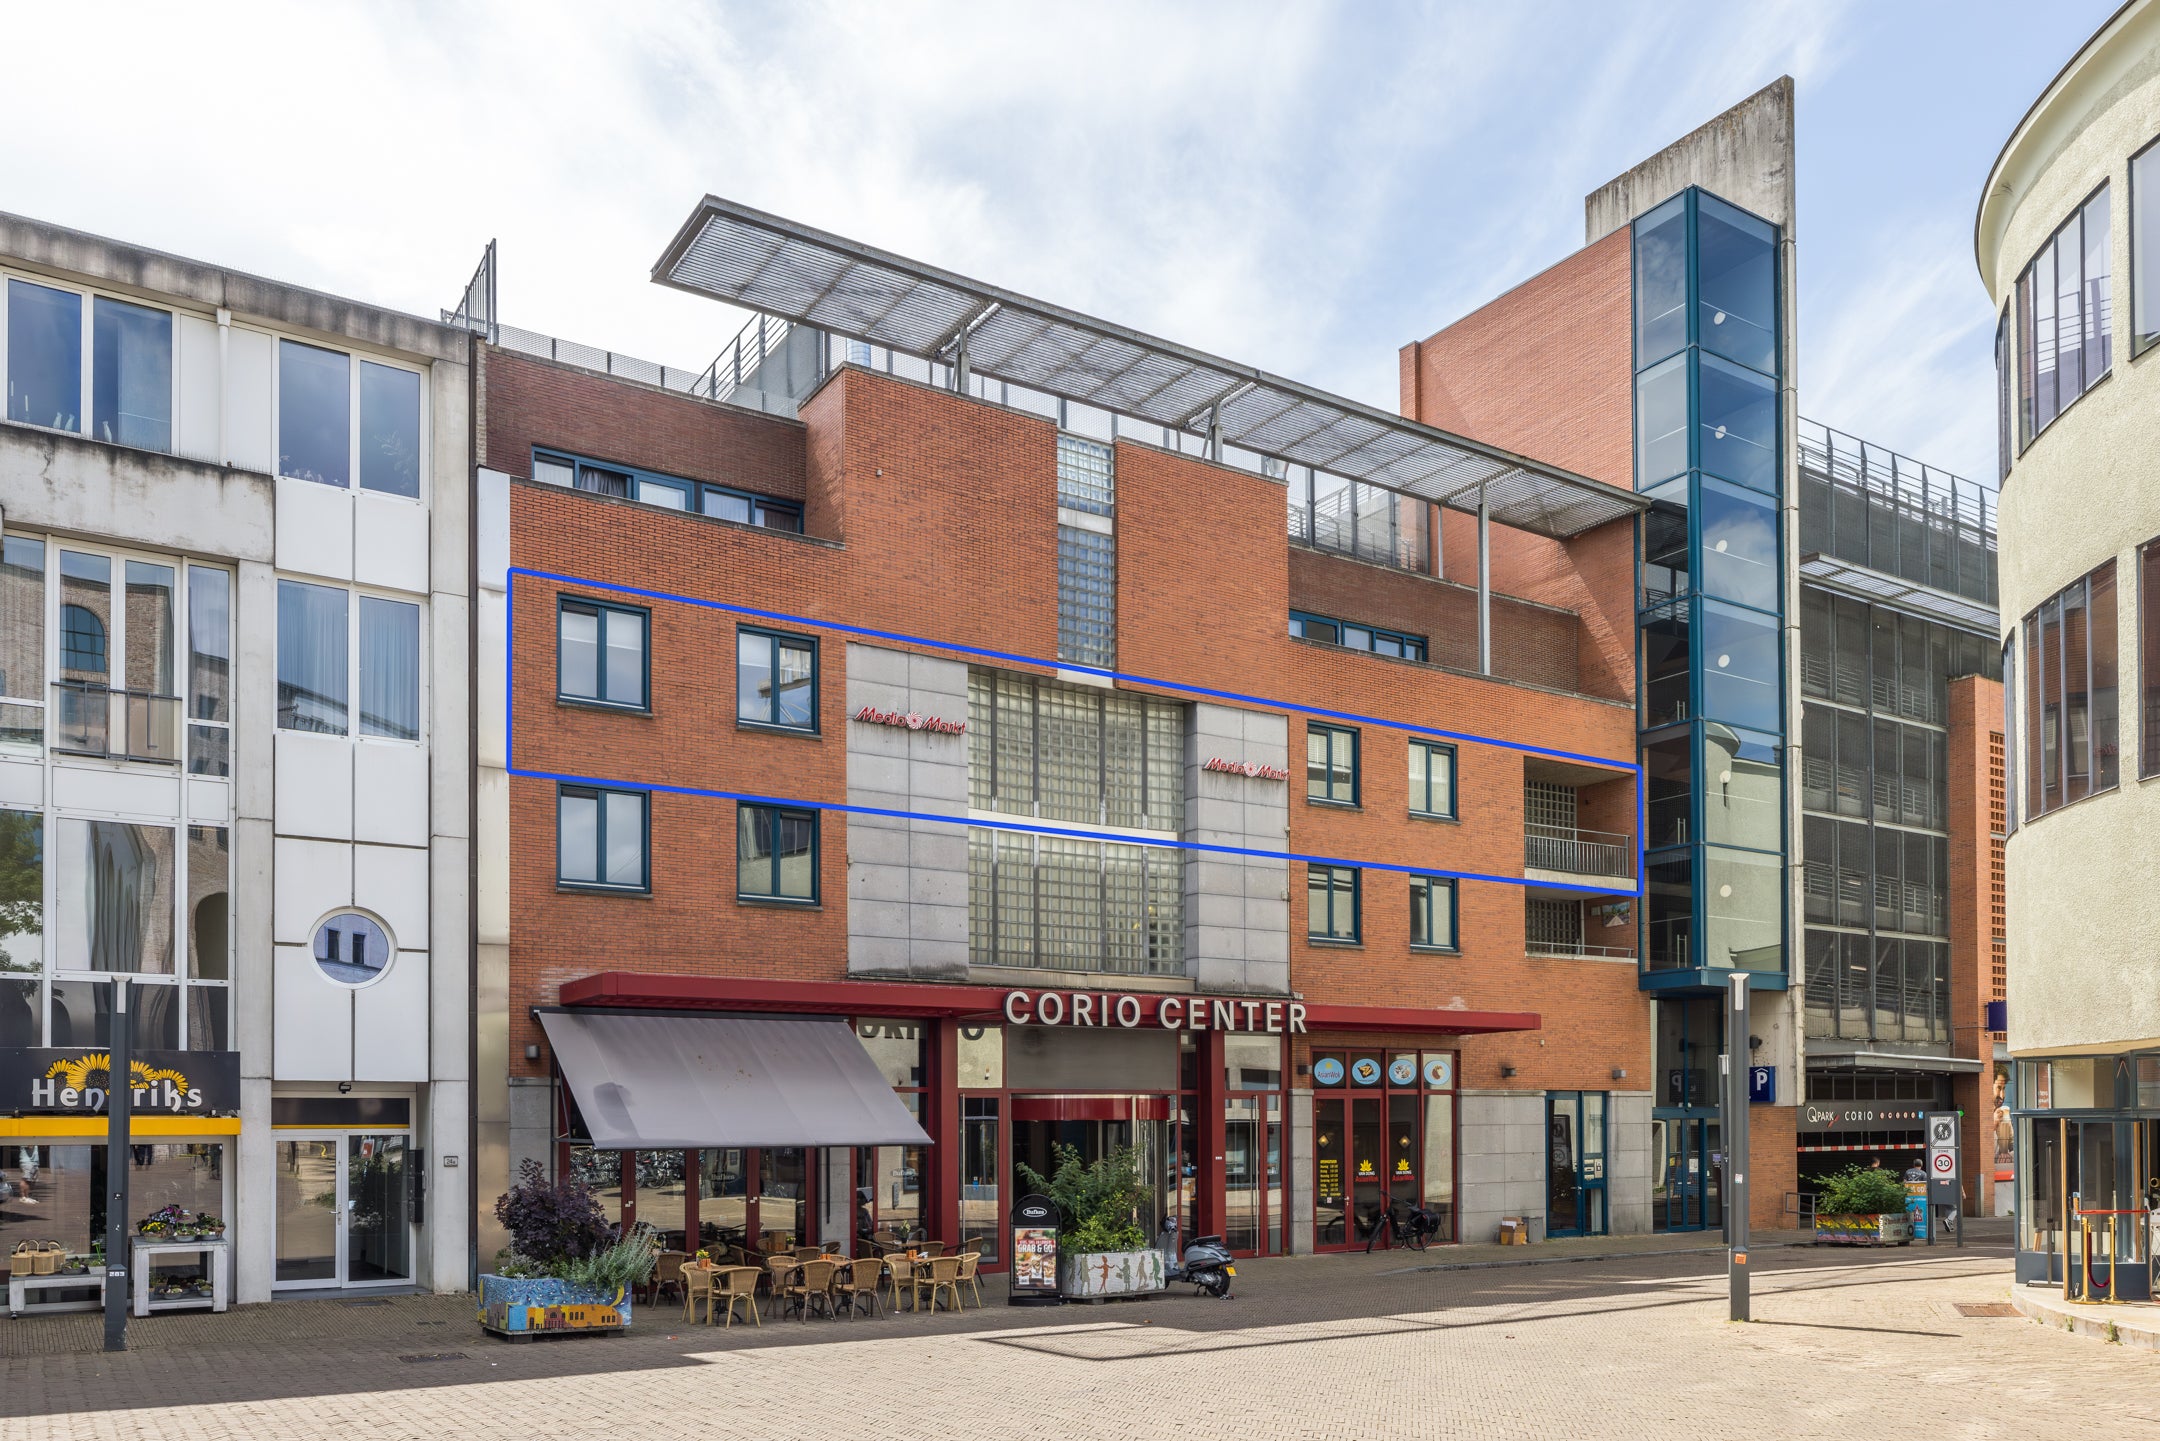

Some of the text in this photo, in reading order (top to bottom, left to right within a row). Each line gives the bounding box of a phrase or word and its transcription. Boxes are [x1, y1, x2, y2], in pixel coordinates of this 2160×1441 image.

[855, 706, 966, 735] Media Markt
[1204, 757, 1291, 780] Media Markt
[1005, 991, 1307, 1034] CORIO CENTER
[1757, 1072, 1767, 1091] P
[32, 1078, 202, 1113] Henriks
[1844, 1111, 1874, 1121] CORIO
[1937, 1159, 1950, 1167] 30
